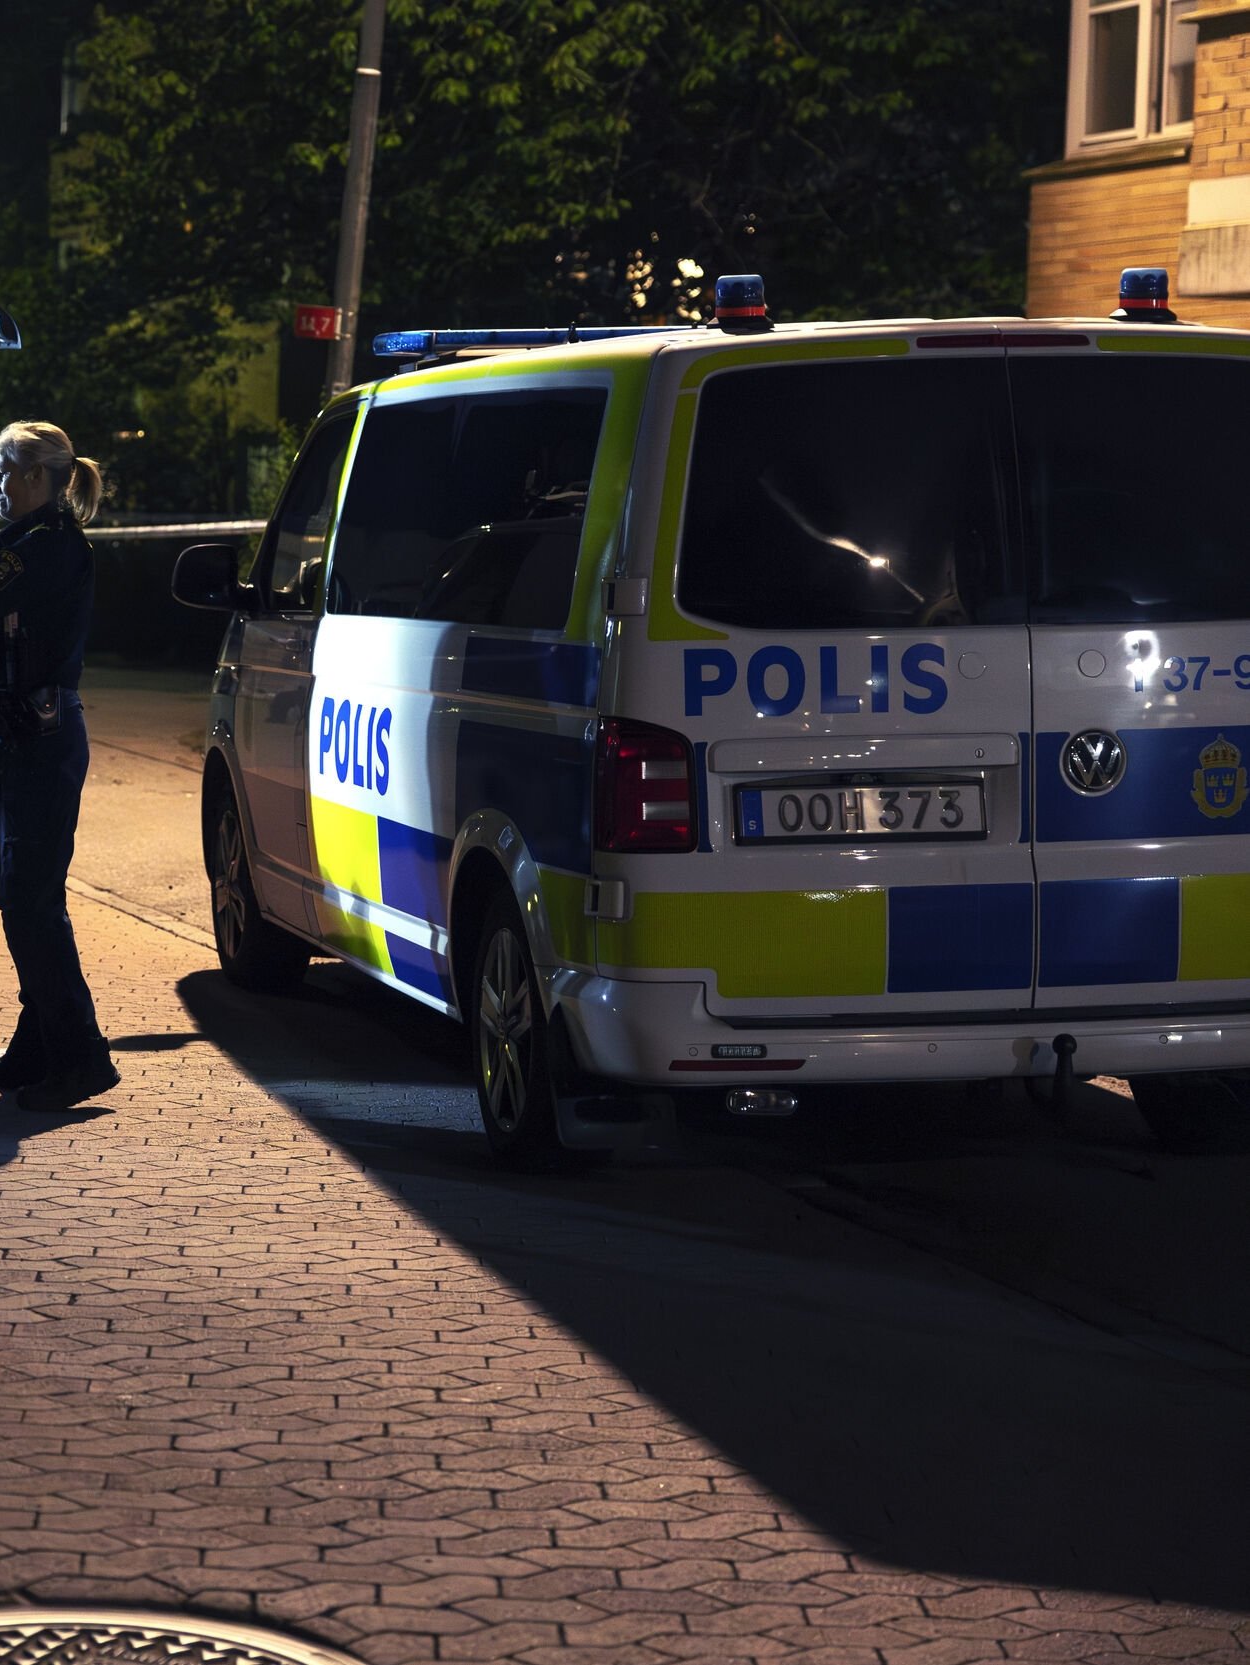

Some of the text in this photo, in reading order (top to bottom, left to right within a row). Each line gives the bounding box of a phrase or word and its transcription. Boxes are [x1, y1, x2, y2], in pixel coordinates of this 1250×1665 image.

[683, 642, 948, 716] POLIS
[319, 696, 392, 796] POLIS
[748, 819, 757, 830] S
[778, 789, 964, 832] OOH 373
